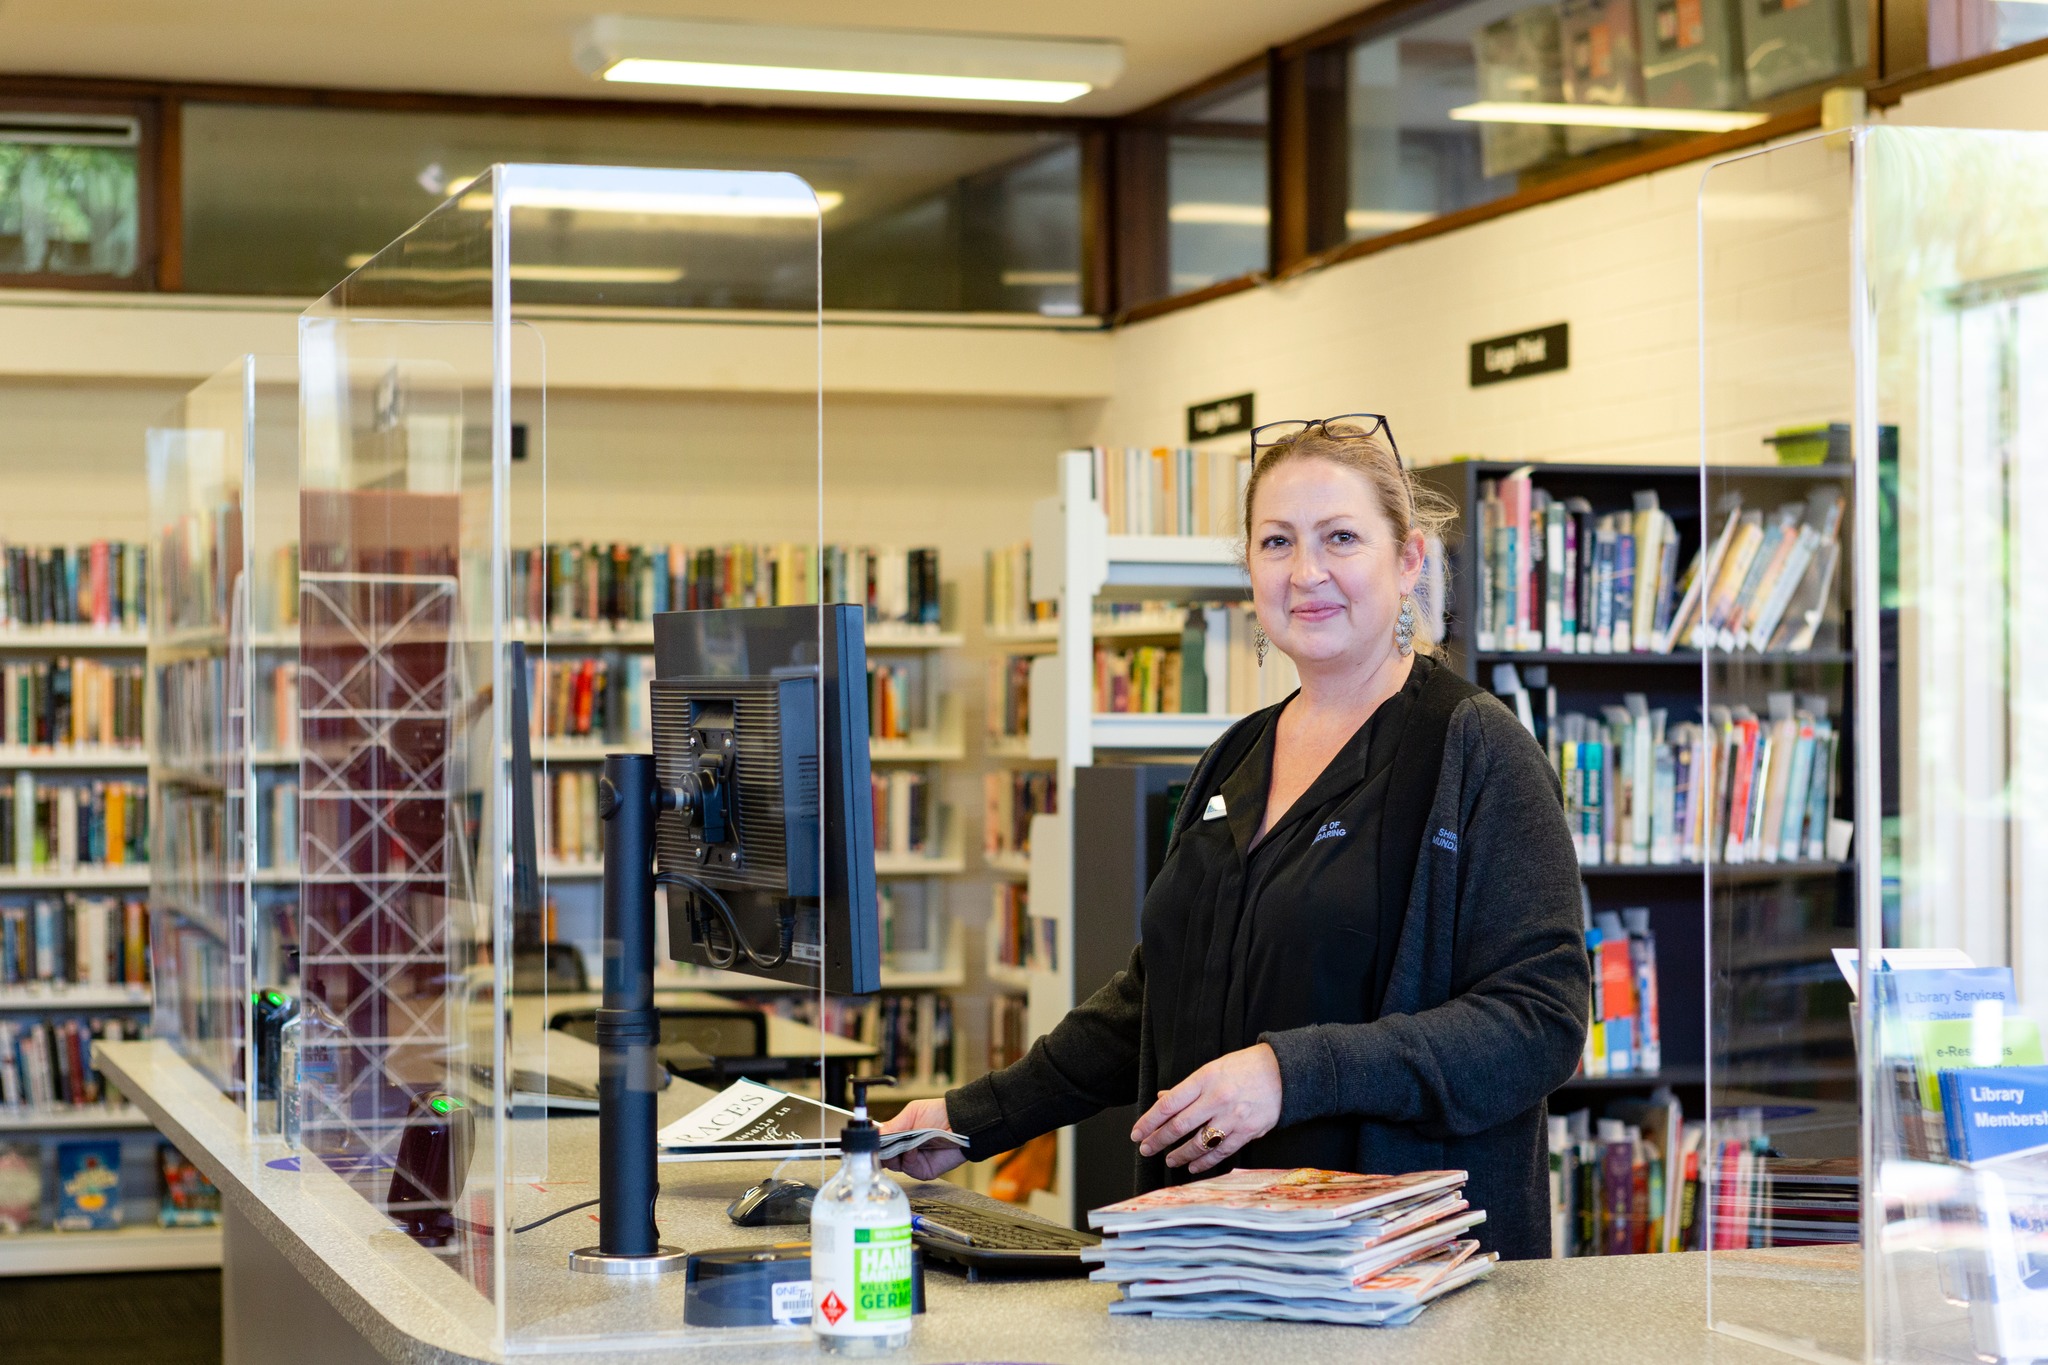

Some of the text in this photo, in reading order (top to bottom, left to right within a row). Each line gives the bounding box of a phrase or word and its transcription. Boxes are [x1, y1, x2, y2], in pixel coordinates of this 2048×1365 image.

[1484, 335, 1547, 375] Large Print
[1329, 820, 1341, 830] OF
[1313, 828, 1347, 844] DARING
[1438, 827, 1458, 842] SHIR
[1905, 989, 2005, 1005] Library Services
[1936, 1045, 2013, 1058] e-Reses
[1970, 1086, 2024, 1104] Library
